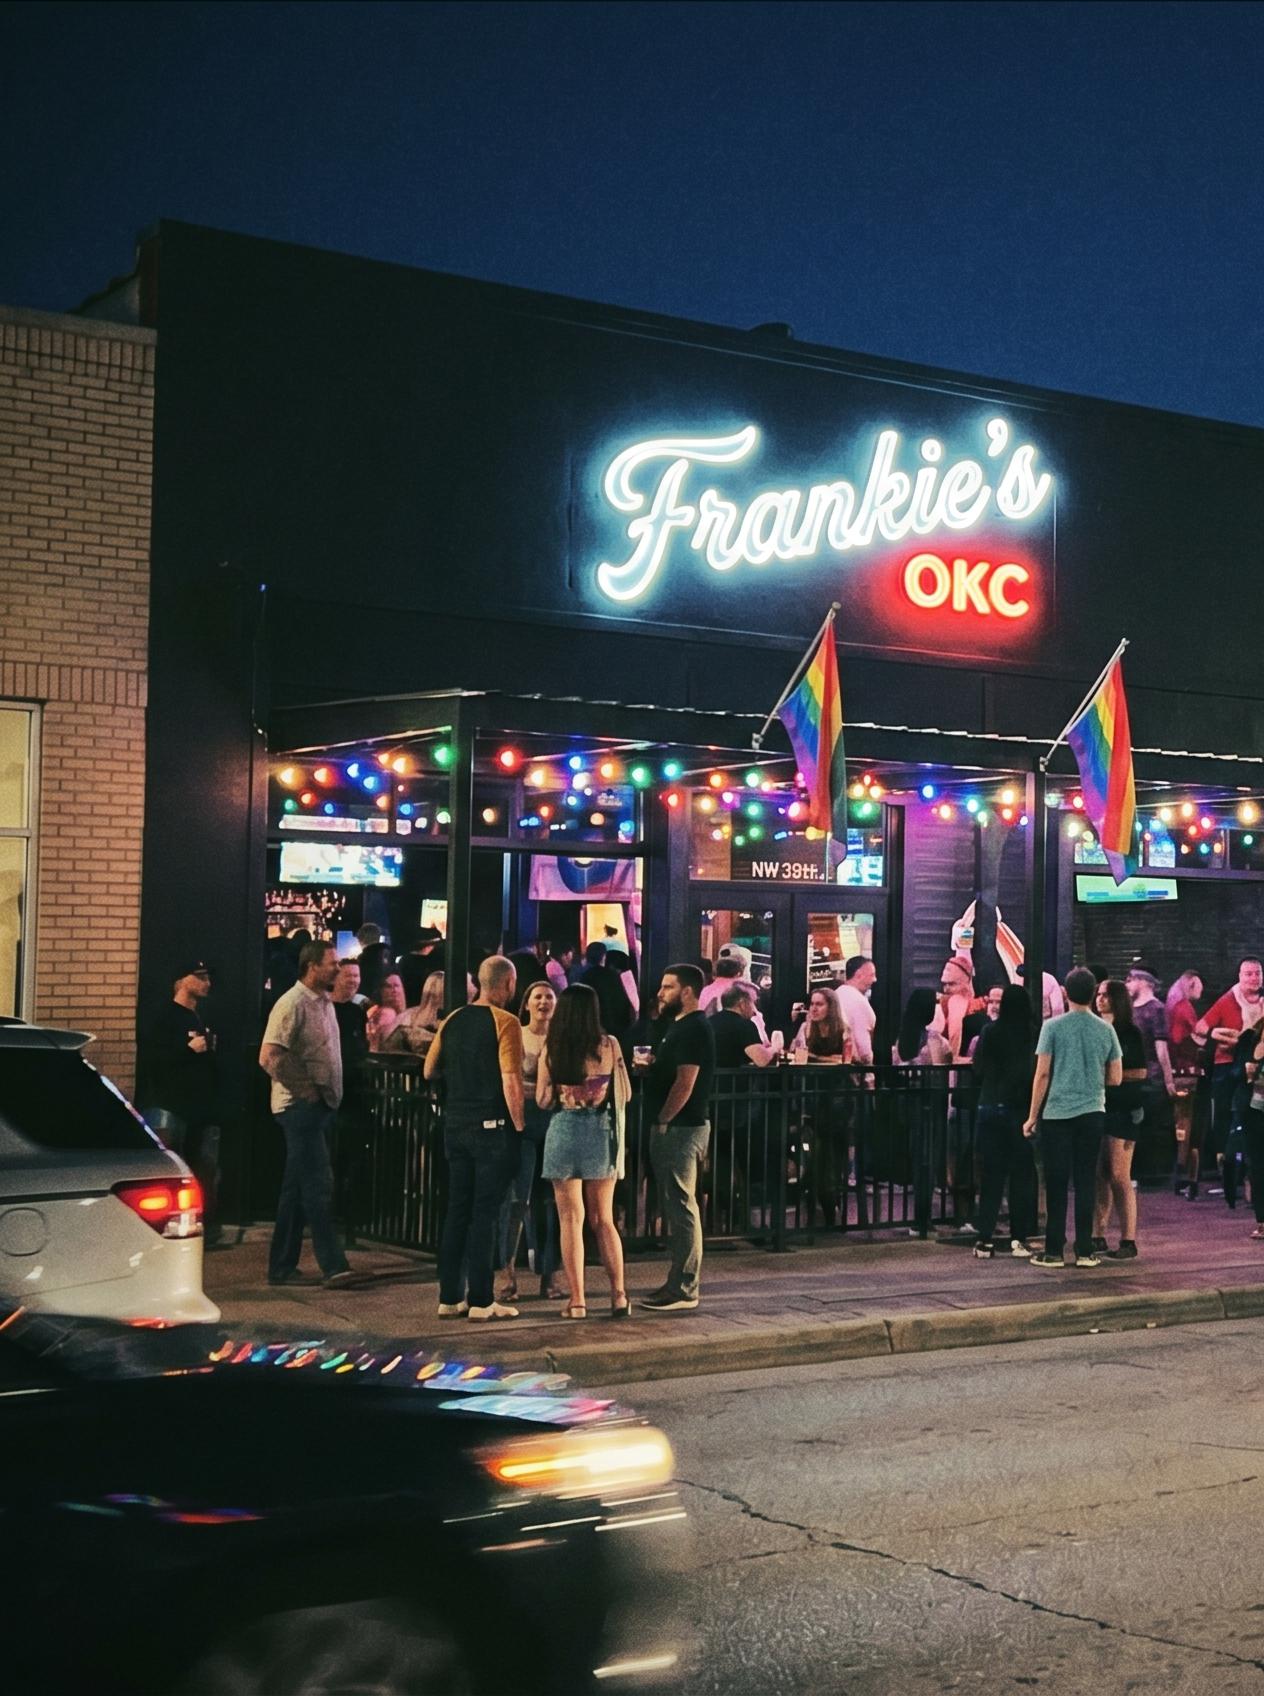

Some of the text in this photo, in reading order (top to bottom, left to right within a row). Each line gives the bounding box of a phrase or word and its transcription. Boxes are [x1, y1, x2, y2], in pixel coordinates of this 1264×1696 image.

[597, 417, 1052, 601] Frankie's
[903, 553, 1030, 618] OKC
[751, 861, 779, 878] NW
